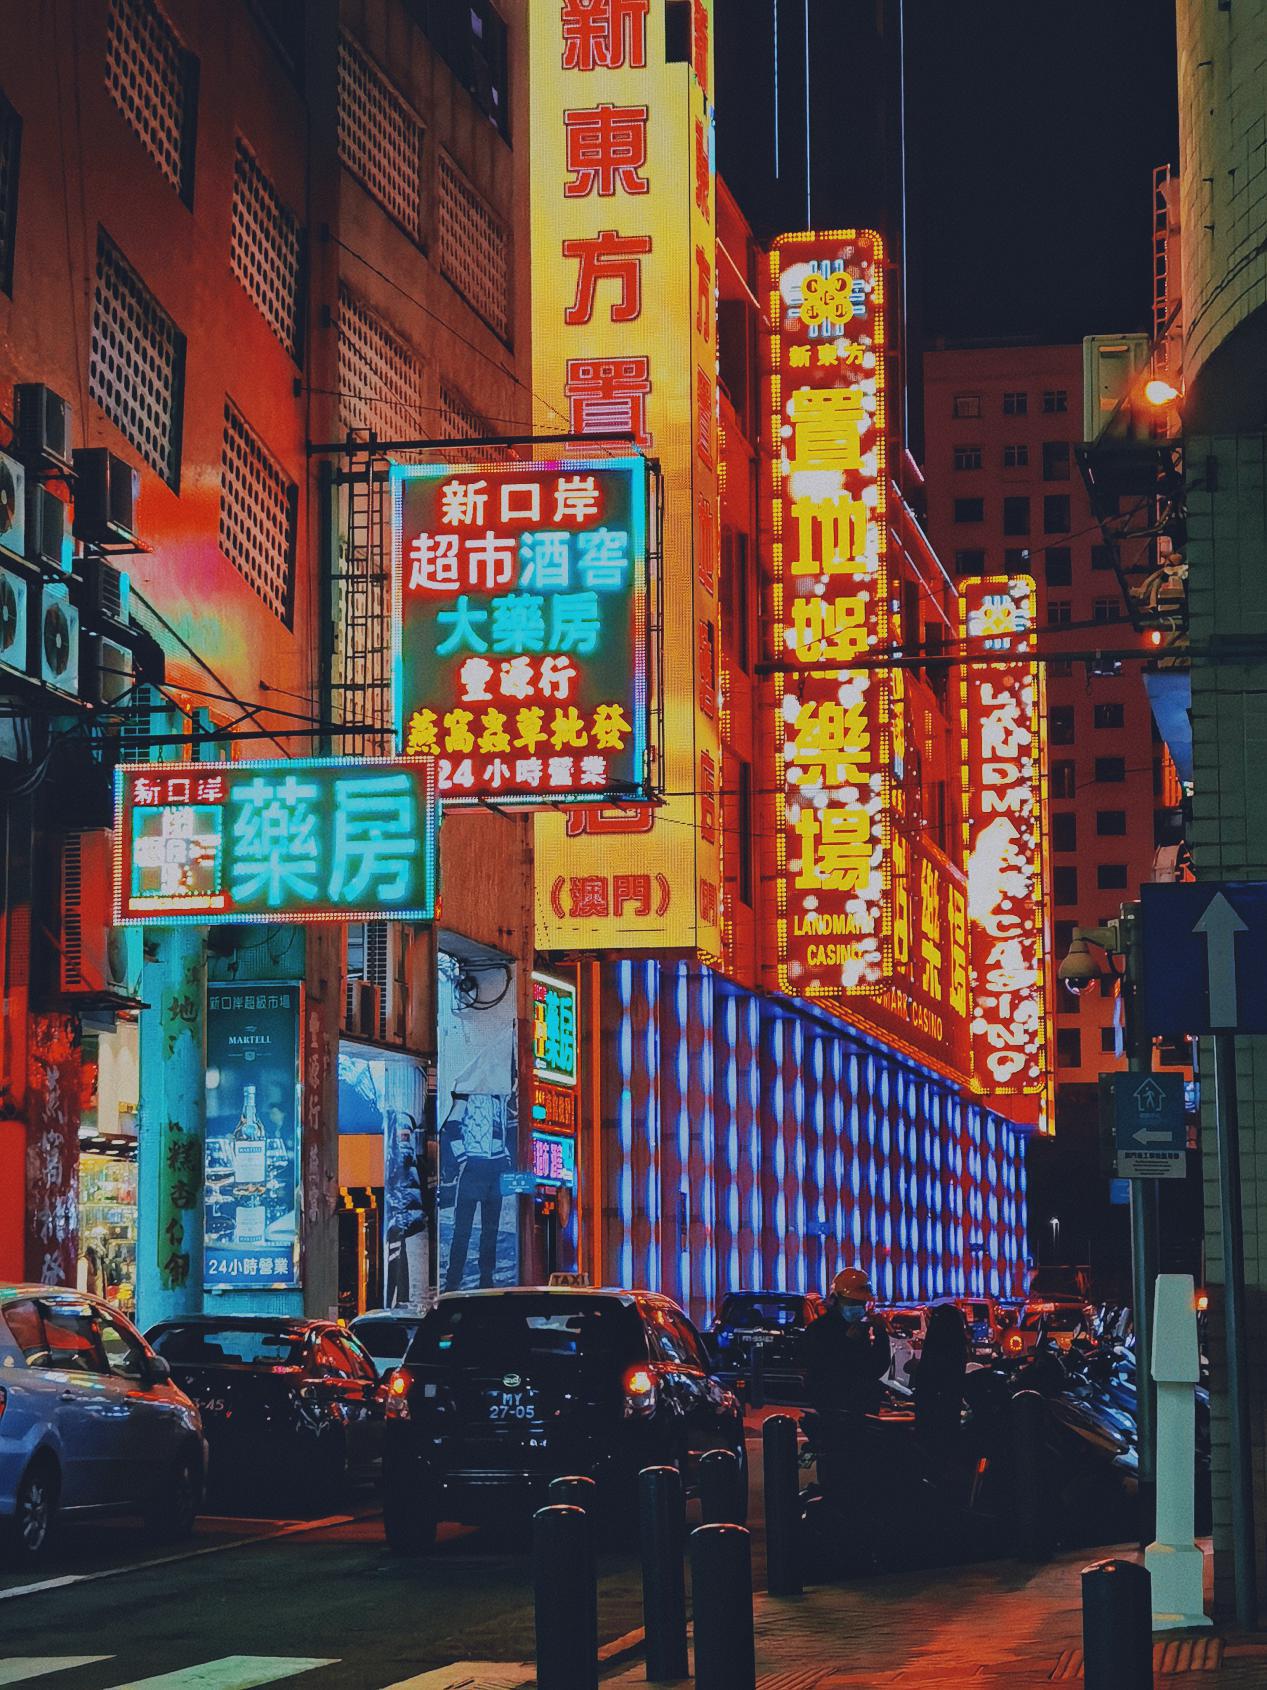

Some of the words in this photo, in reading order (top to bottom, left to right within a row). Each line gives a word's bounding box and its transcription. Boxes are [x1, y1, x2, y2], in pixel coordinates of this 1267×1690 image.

[789, 342, 866, 368] 新東方
[442, 476, 600, 526] 新口岸
[408, 527, 629, 592] 超市酒窖
[436, 591, 601, 655] 大藥房
[406, 703, 632, 756] 燕窩蟲草批發
[439, 756, 607, 790] 24小時營業
[980, 683, 1022, 908] LANDMA
[231, 774, 415, 905] 藥房
[550, 872, 670, 919] (澳門)
[807, 942, 864, 966] CASINO
[229, 1036, 272, 1045] MARTELL
[912, 1001, 943, 1041] CASINO
[209, 1257, 288, 1275] 24小時營業
[489, 1405, 535, 1419] 27-05
[502, 1392, 522, 1405] MY
